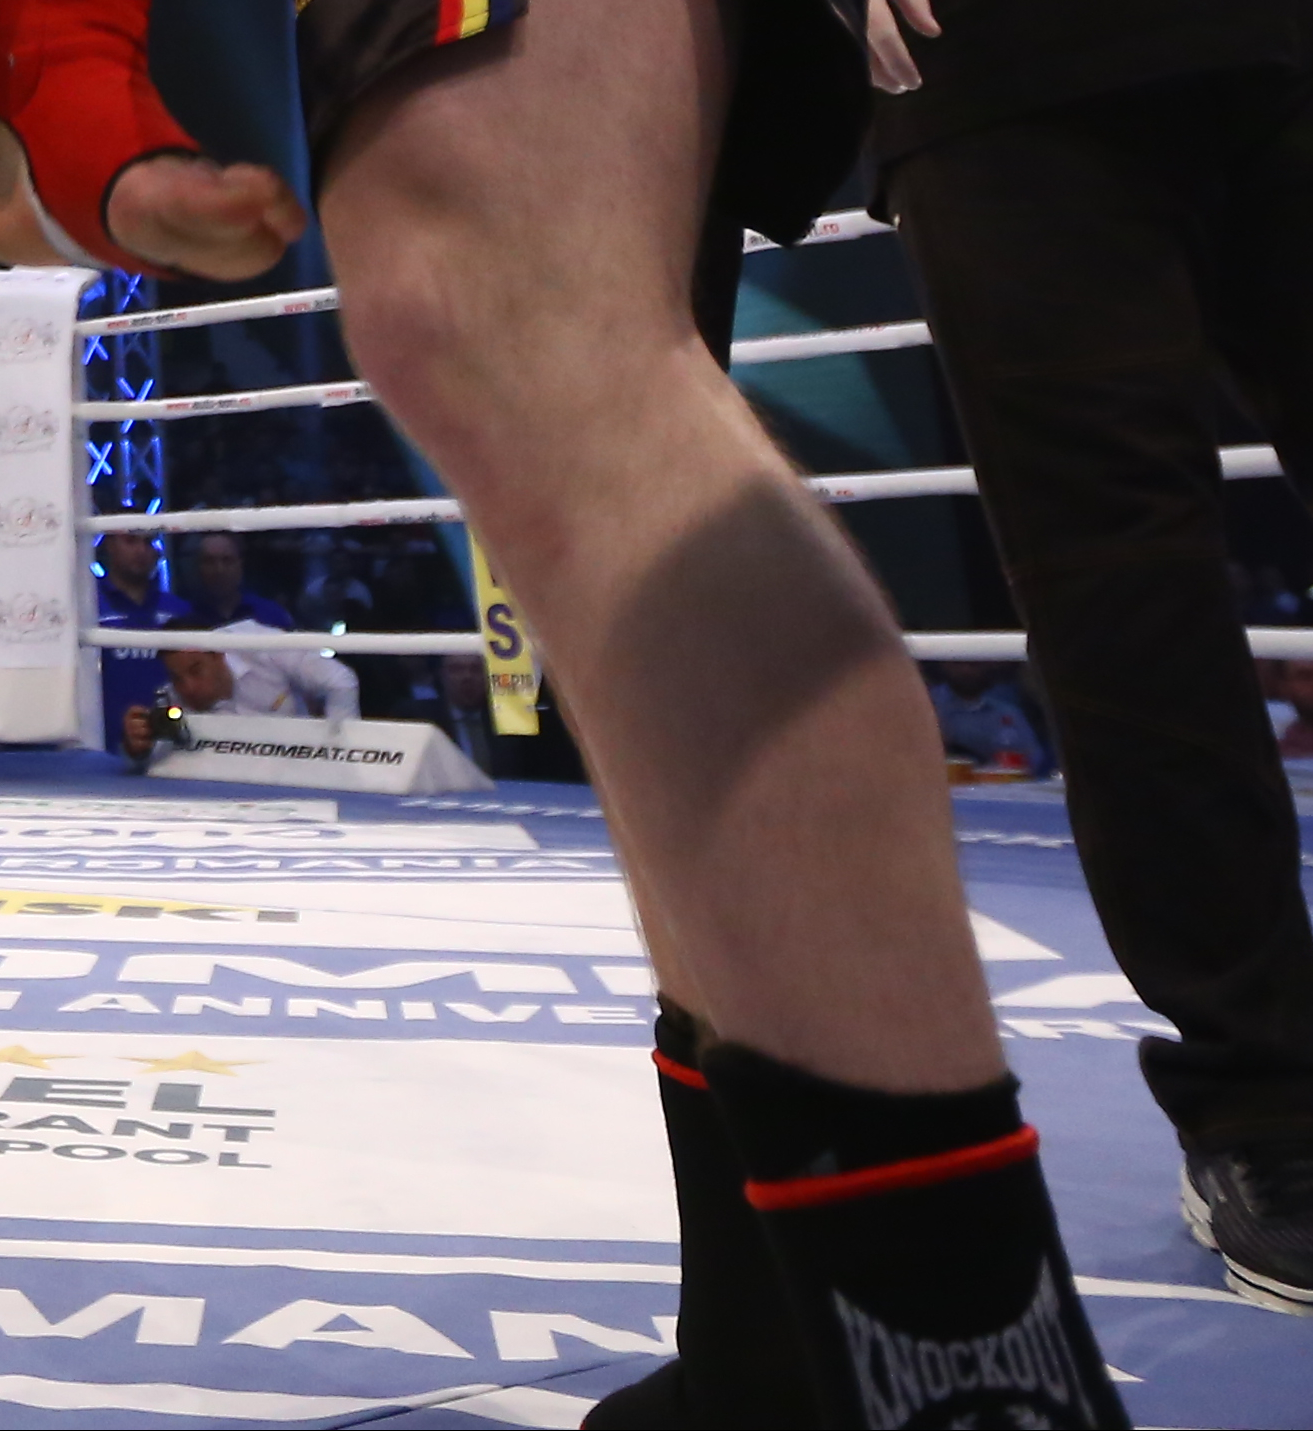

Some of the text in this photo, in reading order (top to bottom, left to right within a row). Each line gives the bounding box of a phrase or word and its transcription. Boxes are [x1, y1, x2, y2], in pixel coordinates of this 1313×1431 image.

[181, 738, 405, 765] UPERKOMBAT.COM
[57, 992, 662, 1027] ANNIVE
[831, 1255, 1098, 1430] KNOCKOUT
